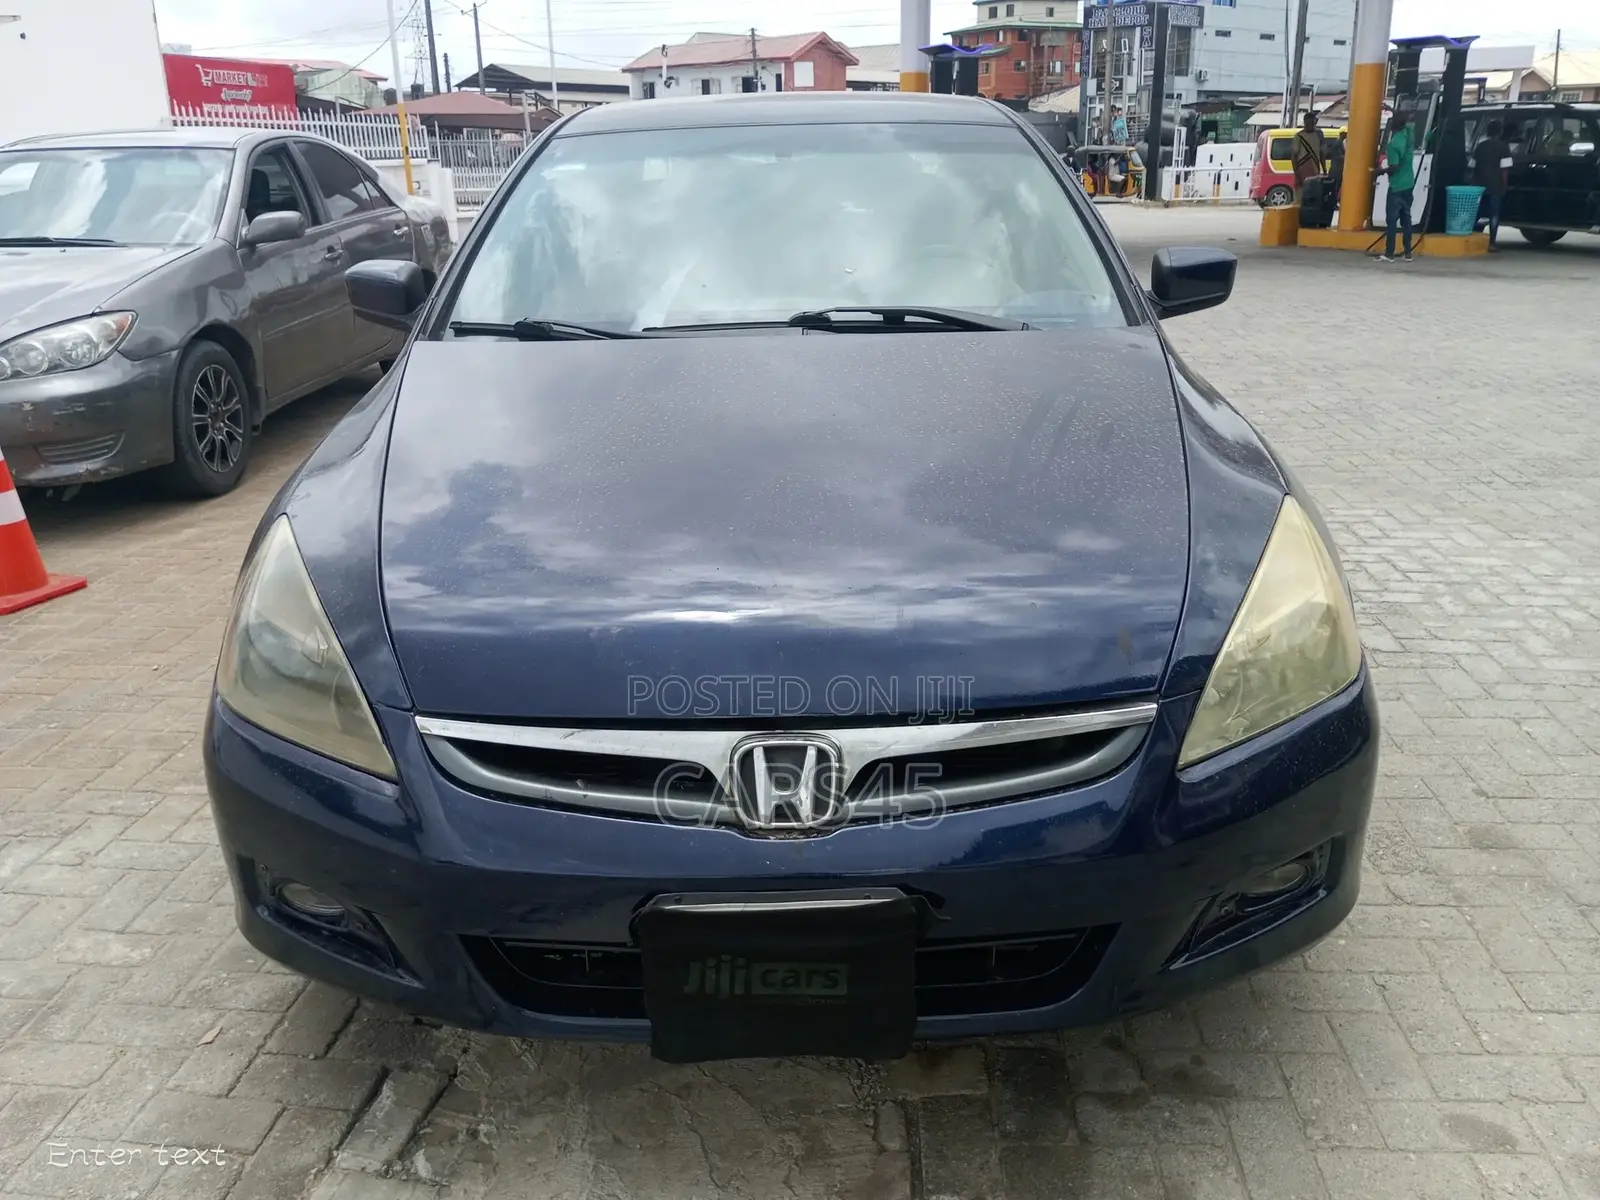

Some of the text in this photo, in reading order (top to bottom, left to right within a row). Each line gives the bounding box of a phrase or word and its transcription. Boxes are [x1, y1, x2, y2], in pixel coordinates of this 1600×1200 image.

[1115, 14, 1150, 26] DEPOT
[214, 70, 247, 86] MARKET
[759, 968, 841, 990] cars
